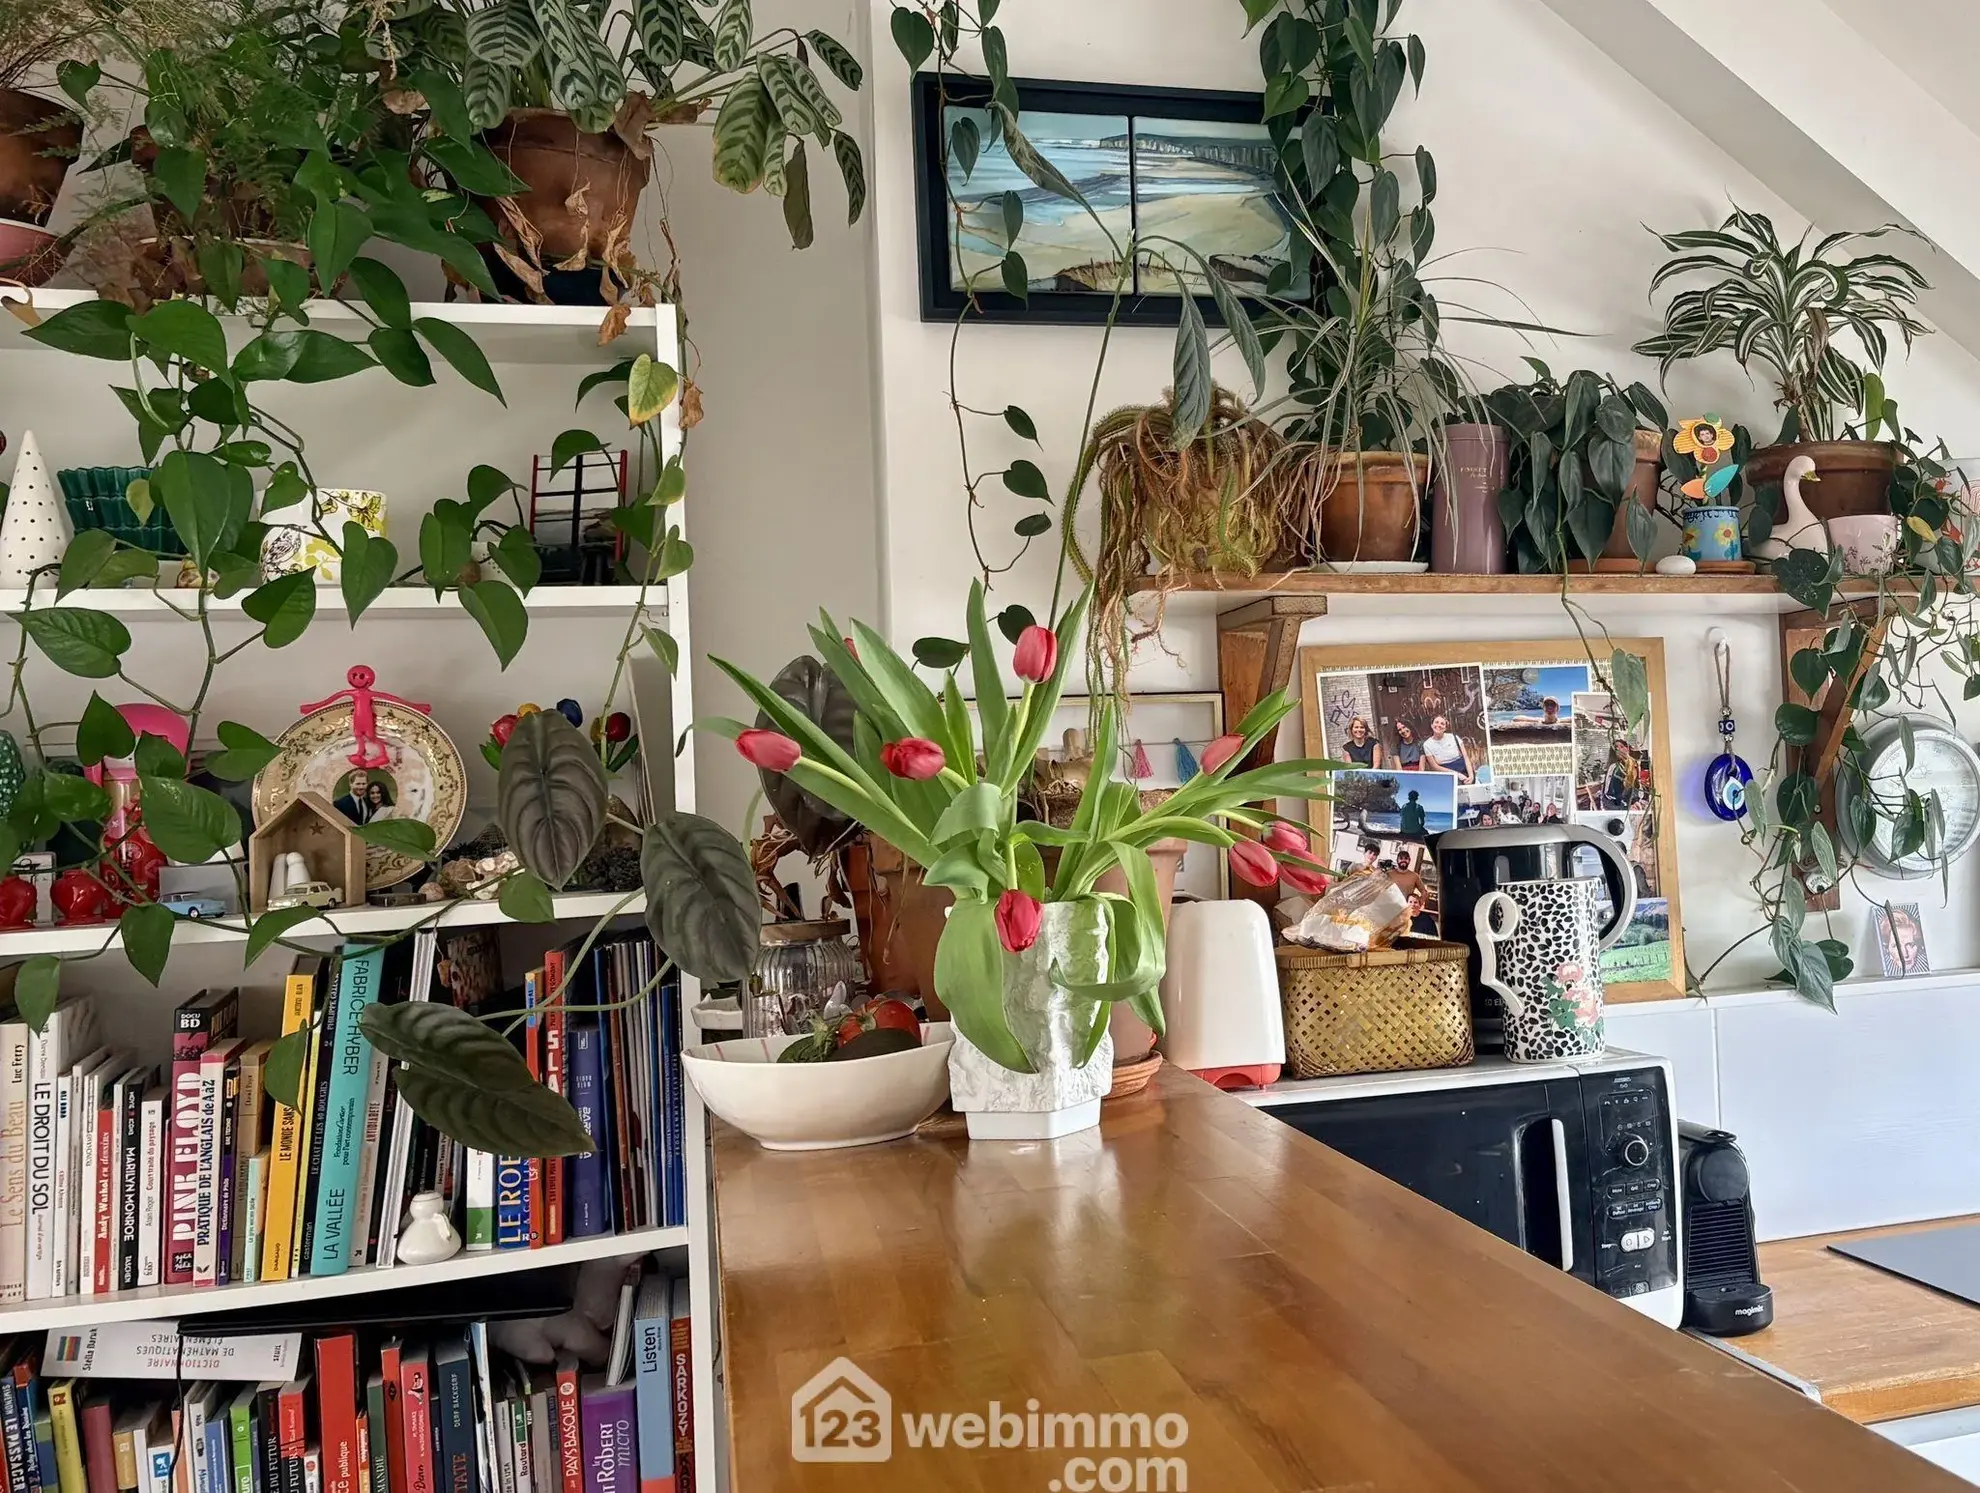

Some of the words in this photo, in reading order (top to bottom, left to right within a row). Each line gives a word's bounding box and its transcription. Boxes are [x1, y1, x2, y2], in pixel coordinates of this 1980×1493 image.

[180, 1019, 201, 1029] BD
[12, 1044, 25, 1066] Ferry
[342, 1024, 358, 1076] HYBER
[12, 1067, 22, 1084] Luc
[34, 1082, 51, 1100] LE
[203, 1104, 214, 1116] de
[204, 1095, 214, 1103] A
[1, 1100, 24, 1139] Beau
[33, 1104, 51, 1153] DROIT
[175, 1072, 201, 1166] FLOYD
[282, 1106, 295, 1125] SANS
[148, 1121, 156, 1147] paysage
[200, 1117, 214, 1172] L'ANGLAIS
[281, 1126, 294, 1150] MONDE
[333, 1132, 343, 1158] Fondation
[0, 1142, 24, 1163] du
[280, 1150, 292, 1162] LE
[342, 1152, 351, 1165] pour
[32, 1157, 50, 1180] DU
[125, 1147, 136, 1192] MARILYN
[145, 1173, 153, 1191] Court
[200, 1173, 212, 1188] DE
[0, 1169, 24, 1203] Sens
[32, 1183, 50, 1215] SOL
[99, 1179, 109, 1212] Warhol
[522, 1158, 530, 1213] COLLIN
[0, 1208, 23, 1228] Le
[124, 1193, 135, 1242] MONROE
[172, 1174, 200, 1242] PINK
[197, 1192, 211, 1246] PRATIQUE
[325, 1187, 346, 1238] VALLÉE
[98, 1215, 110, 1239] Andy
[303, 1221, 312, 1260] casterman
[499, 1212, 521, 1243] LE
[323, 1242, 338, 1260] LA
[124, 1255, 132, 1283] TASCHEN
[1734, 1304, 1764, 1316] magimix
[151, 1334, 223, 1346] ÉLÉMENAIRES
[222, 1347, 235, 1357] DE
[643, 1326, 657, 1373] Listen
[83, 1347, 94, 1371] Stella
[452, 1373, 460, 1410] BACKDERF
[675, 1354, 690, 1436] SARKOZY
[5, 1417, 18, 1432] LE
[562, 1399, 576, 1447] BASQUE
[267, 1437, 278, 1473] FUTUR
[337, 1441, 349, 1477] publique
[616, 1420, 630, 1467] micro
[7, 1433, 27, 1491] PASSAGER
[289, 1454, 300, 1487] FUTUR
[375, 1456, 386, 1493] MANDIE
[453, 1453, 468, 1493] TATE
[520, 1443, 528, 1477] Routard
[565, 1447, 577, 1477] PAYS
[269, 1475, 279, 1491] DU
